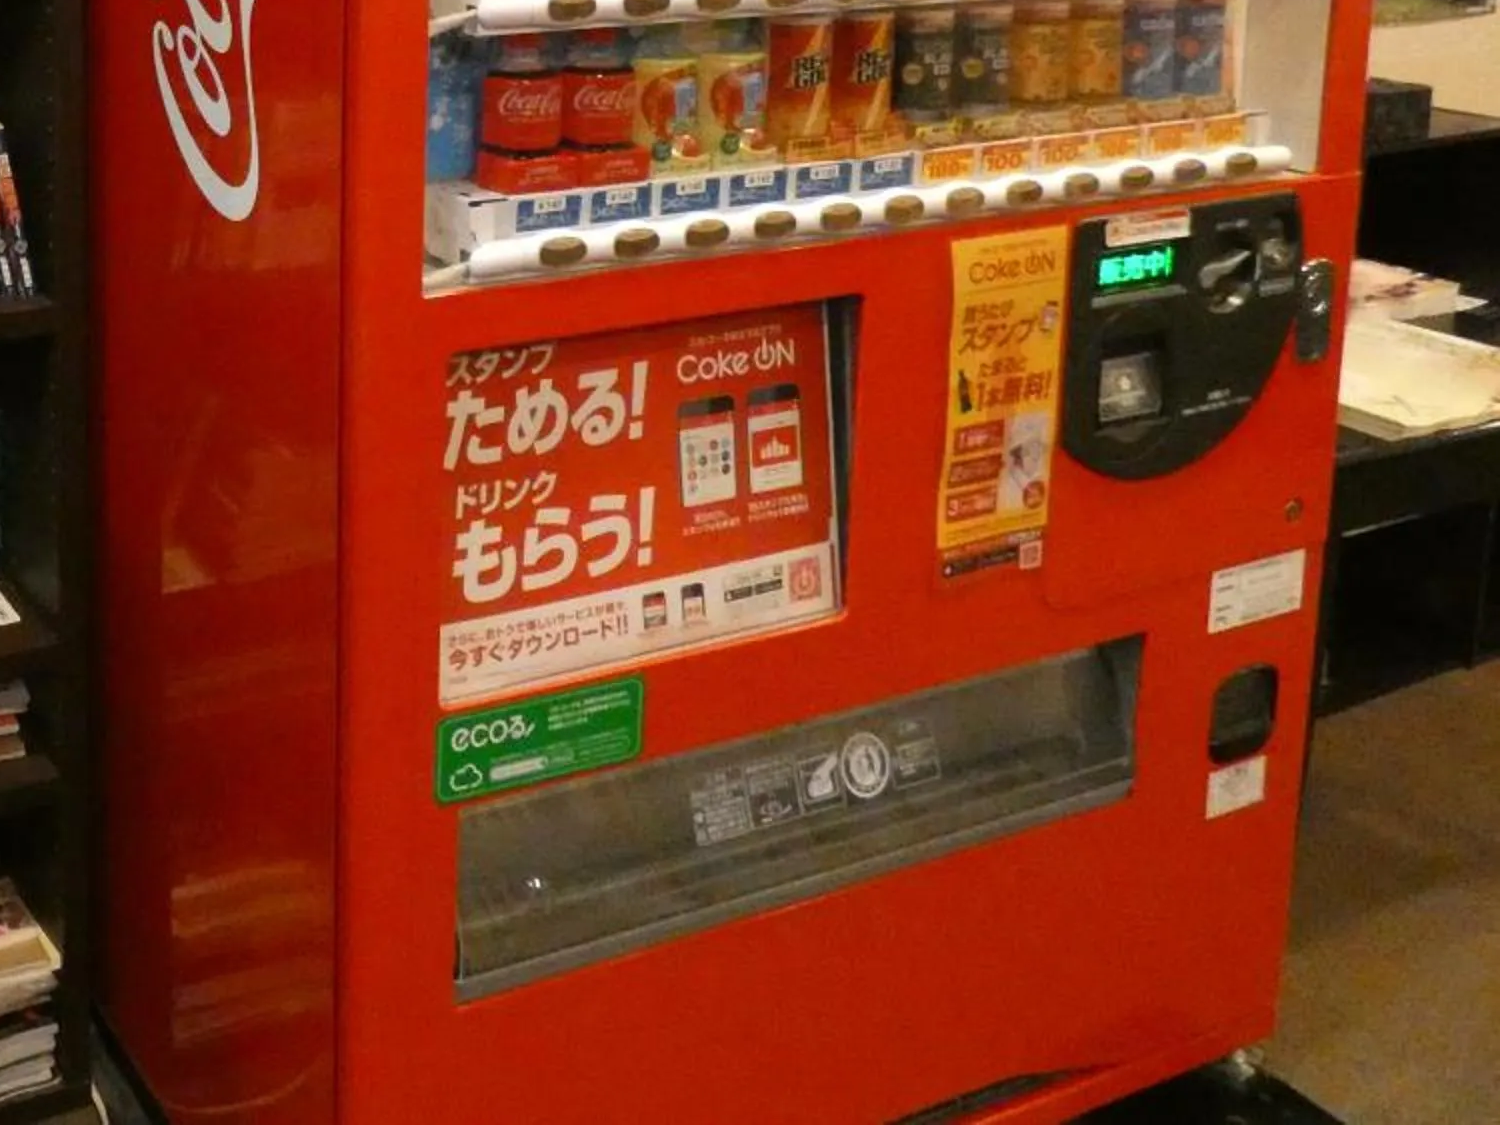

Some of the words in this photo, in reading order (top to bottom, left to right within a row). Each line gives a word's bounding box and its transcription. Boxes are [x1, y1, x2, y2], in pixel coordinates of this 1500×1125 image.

[969, 258, 1022, 284] Coke
[445, 343, 558, 388] スタンプ
[676, 350, 750, 384] Coke
[753, 336, 796, 371] ON
[443, 360, 650, 471] ためる!
[455, 471, 558, 521] ドリンク
[451, 486, 656, 605] もらう!
